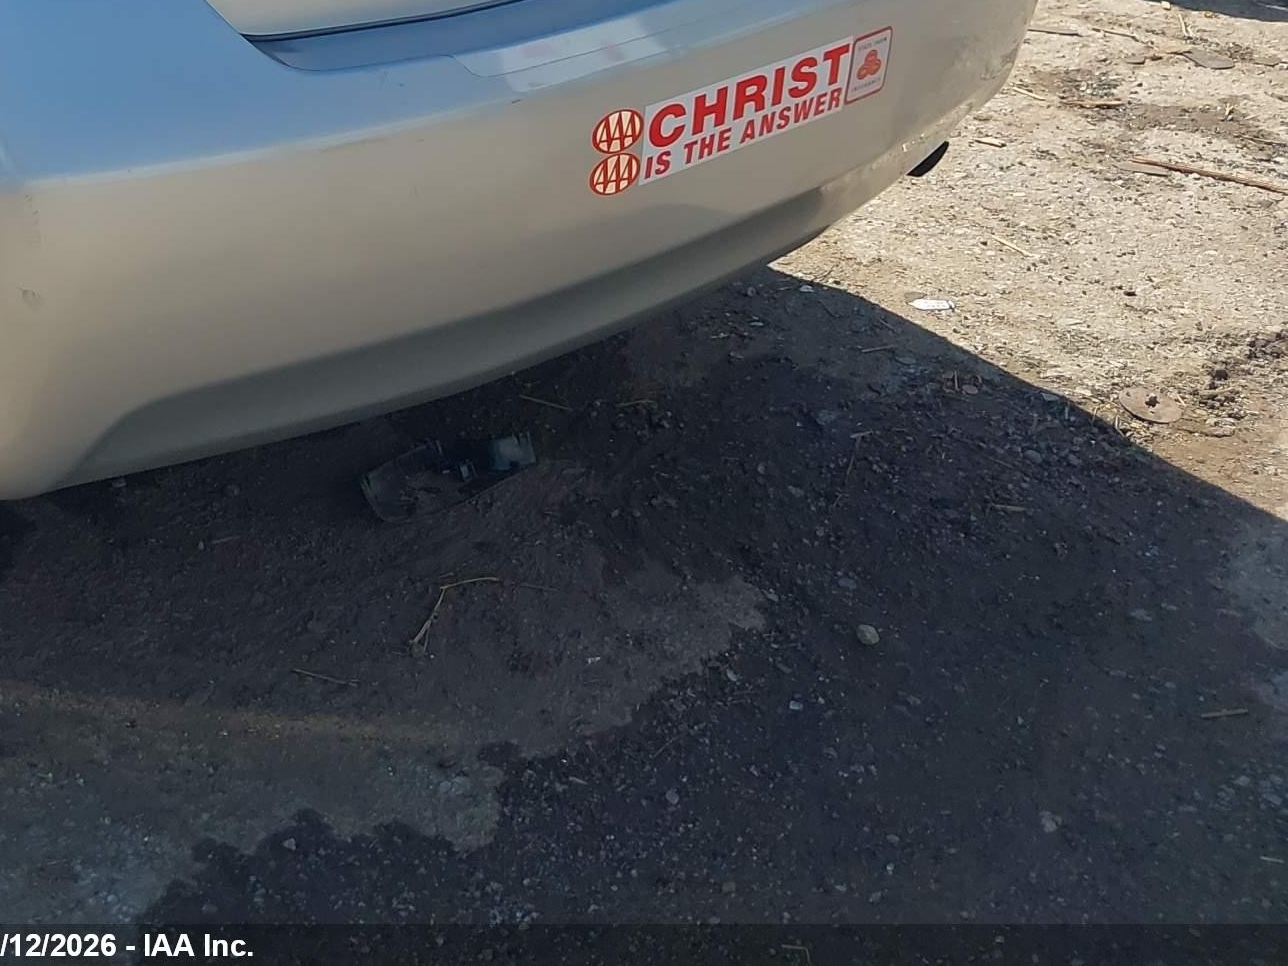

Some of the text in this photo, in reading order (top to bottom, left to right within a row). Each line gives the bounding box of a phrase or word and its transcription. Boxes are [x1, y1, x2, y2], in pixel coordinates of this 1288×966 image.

[648, 43, 850, 148] CHRIST
[593, 110, 641, 154] AAA
[644, 87, 843, 180] IS THE ANSWER
[590, 154, 639, 195] AAA
